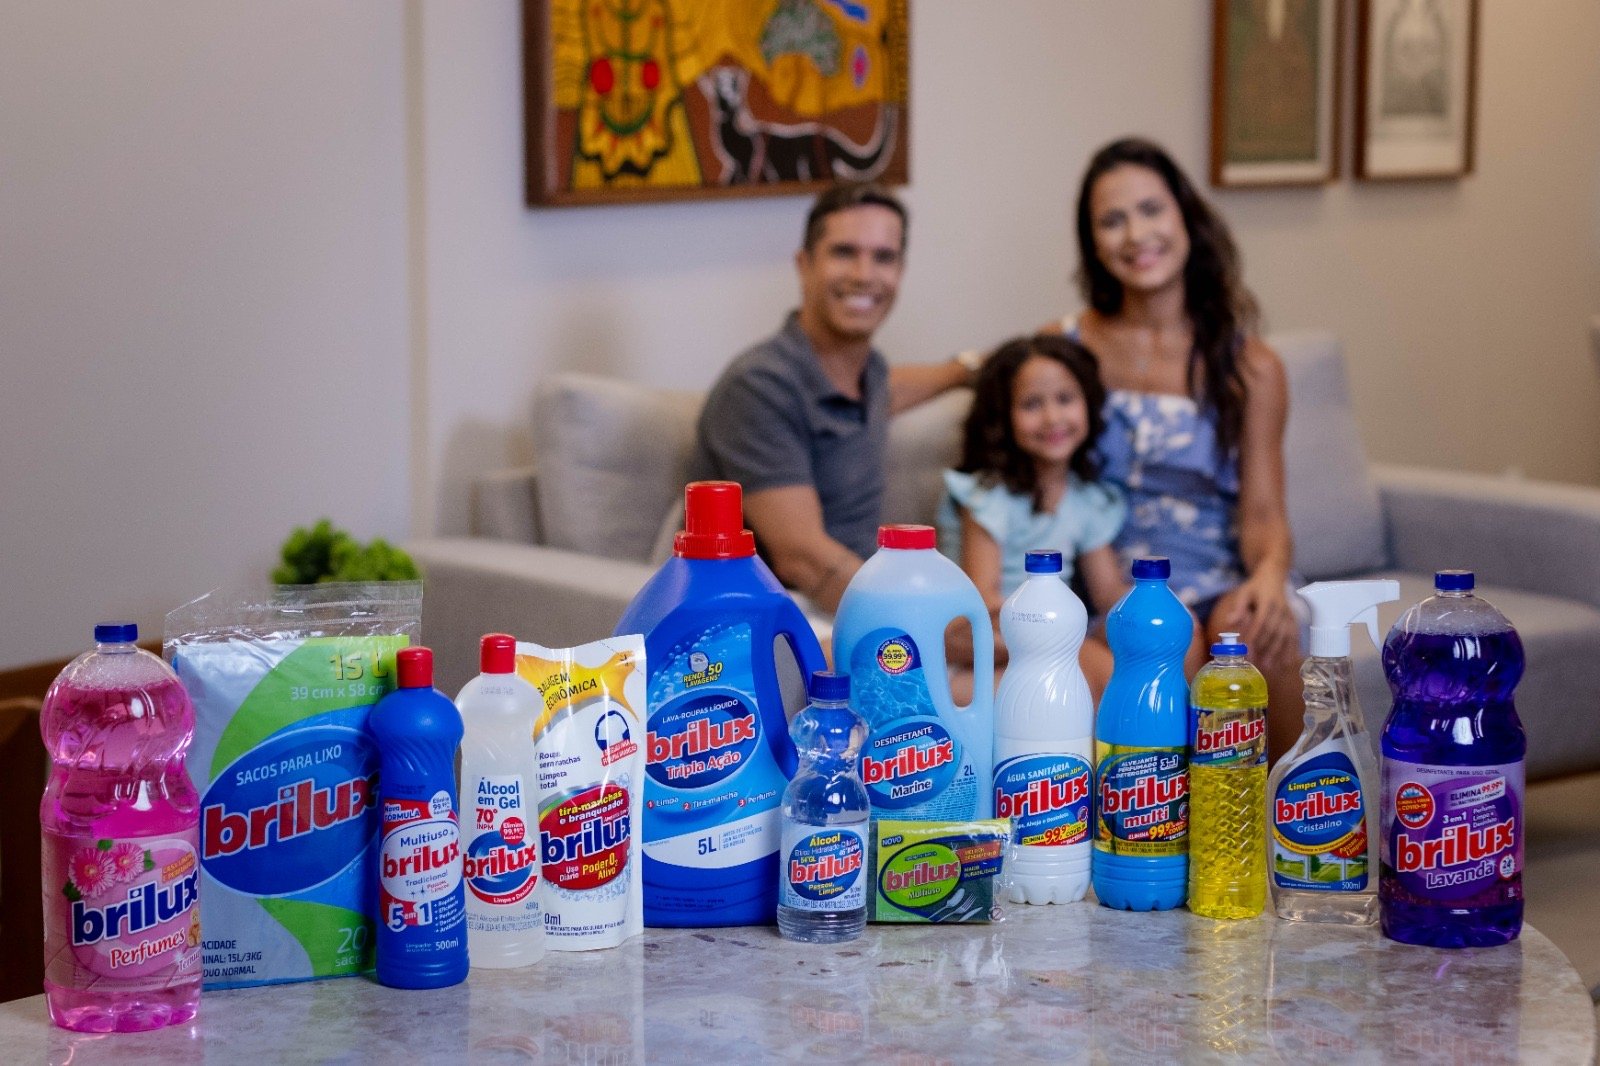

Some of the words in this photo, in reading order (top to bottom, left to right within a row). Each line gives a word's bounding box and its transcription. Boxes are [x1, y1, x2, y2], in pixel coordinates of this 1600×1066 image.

[329, 654, 364, 680] 15
[683, 671, 706, 682] RENDE
[708, 662, 723, 676] 50
[291, 686, 308, 700] 39
[312, 688, 333, 698] cm
[337, 687, 345, 697] x
[348, 684, 366, 697] 58
[537, 672, 570, 696] BALAGEM
[546, 678, 598, 710] ECONÔMICA
[662, 706, 708, 724] LAVA-ROUPAS
[710, 699, 738, 712] LÍQUIDO
[646, 714, 755, 764] brilux
[874, 726, 933, 748] DESINFETANTE
[1196, 718, 1265, 752] brilux
[236, 763, 277, 786] SACOS
[280, 753, 312, 774] PARA
[315, 744, 342, 764] LIXO
[666, 762, 704, 780] Tripla
[708, 750, 740, 770] Ação
[862, 740, 954, 785] brilux
[964, 765, 974, 776] 2L
[1118, 762, 1158, 772] PERFUMADO
[1122, 756, 1158, 766] ALVEJANTE
[1007, 773, 1026, 783] ÁGUA
[1028, 762, 1070, 778] SANITÁRIA
[1116, 767, 1157, 778] DETERGENTE
[1416, 768, 1454, 776] DESINFETANTE
[478, 776, 519, 796] Álcool
[540, 780, 558, 790] total
[890, 779, 932, 799] Marine
[1102, 772, 1190, 814] brilux
[1288, 782, 1317, 792] Limpa
[1320, 776, 1350, 786] Vidros
[478, 797, 494, 806] em
[498, 796, 520, 810] Gel
[558, 790, 622, 816] tira-manchas
[656, 796, 678, 807] Limpa
[692, 791, 738, 808] Tira-mancha
[996, 771, 1088, 818] brilux
[1450, 790, 1481, 800] ELIMINA
[203, 771, 380, 860] brilux
[476, 808, 498, 823] 70°
[568, 799, 624, 822] branqueador
[1124, 806, 1170, 828] multi
[1276, 790, 1360, 824] brilux
[1297, 819, 1342, 834] Cristalino
[1443, 815, 1449, 824] 3
[1462, 812, 1466, 820] 1
[400, 829, 448, 848] Multiuso
[540, 815, 630, 865] brilux
[698, 836, 717, 855] 5L
[810, 832, 840, 847] Álcool
[882, 836, 902, 847] NOVO
[1024, 835, 1044, 844] ELIMINA
[1128, 832, 1149, 840] ELIMINA
[1397, 816, 1514, 872] brilux
[383, 838, 460, 879] brilux
[462, 842, 536, 878] brilux
[566, 866, 579, 874] Uso
[582, 858, 608, 876] Poder
[791, 850, 862, 884] brilux
[405, 870, 448, 887] Tradicional
[560, 872, 580, 882] Diário
[598, 866, 616, 880] Ativo
[886, 860, 960, 891] brilux
[1426, 860, 1494, 890] Lavanda
[908, 888, 940, 900] Multiuso
[1342, 881, 1360, 890] 500ml
[72, 866, 198, 946] brilux
[390, 906, 404, 930] 5
[404, 912, 416, 920] em
[419, 902, 430, 922] 1
[544, 913, 561, 925] 0ml
[110, 928, 186, 969] Perfumes
[202, 940, 236, 950] ACIDADE
[336, 925, 368, 954] 20
[436, 937, 459, 951] 500ml
[228, 951, 262, 963] 15L/3KG
[203, 969, 220, 977] DUO
[222, 966, 256, 976] NORMAL
